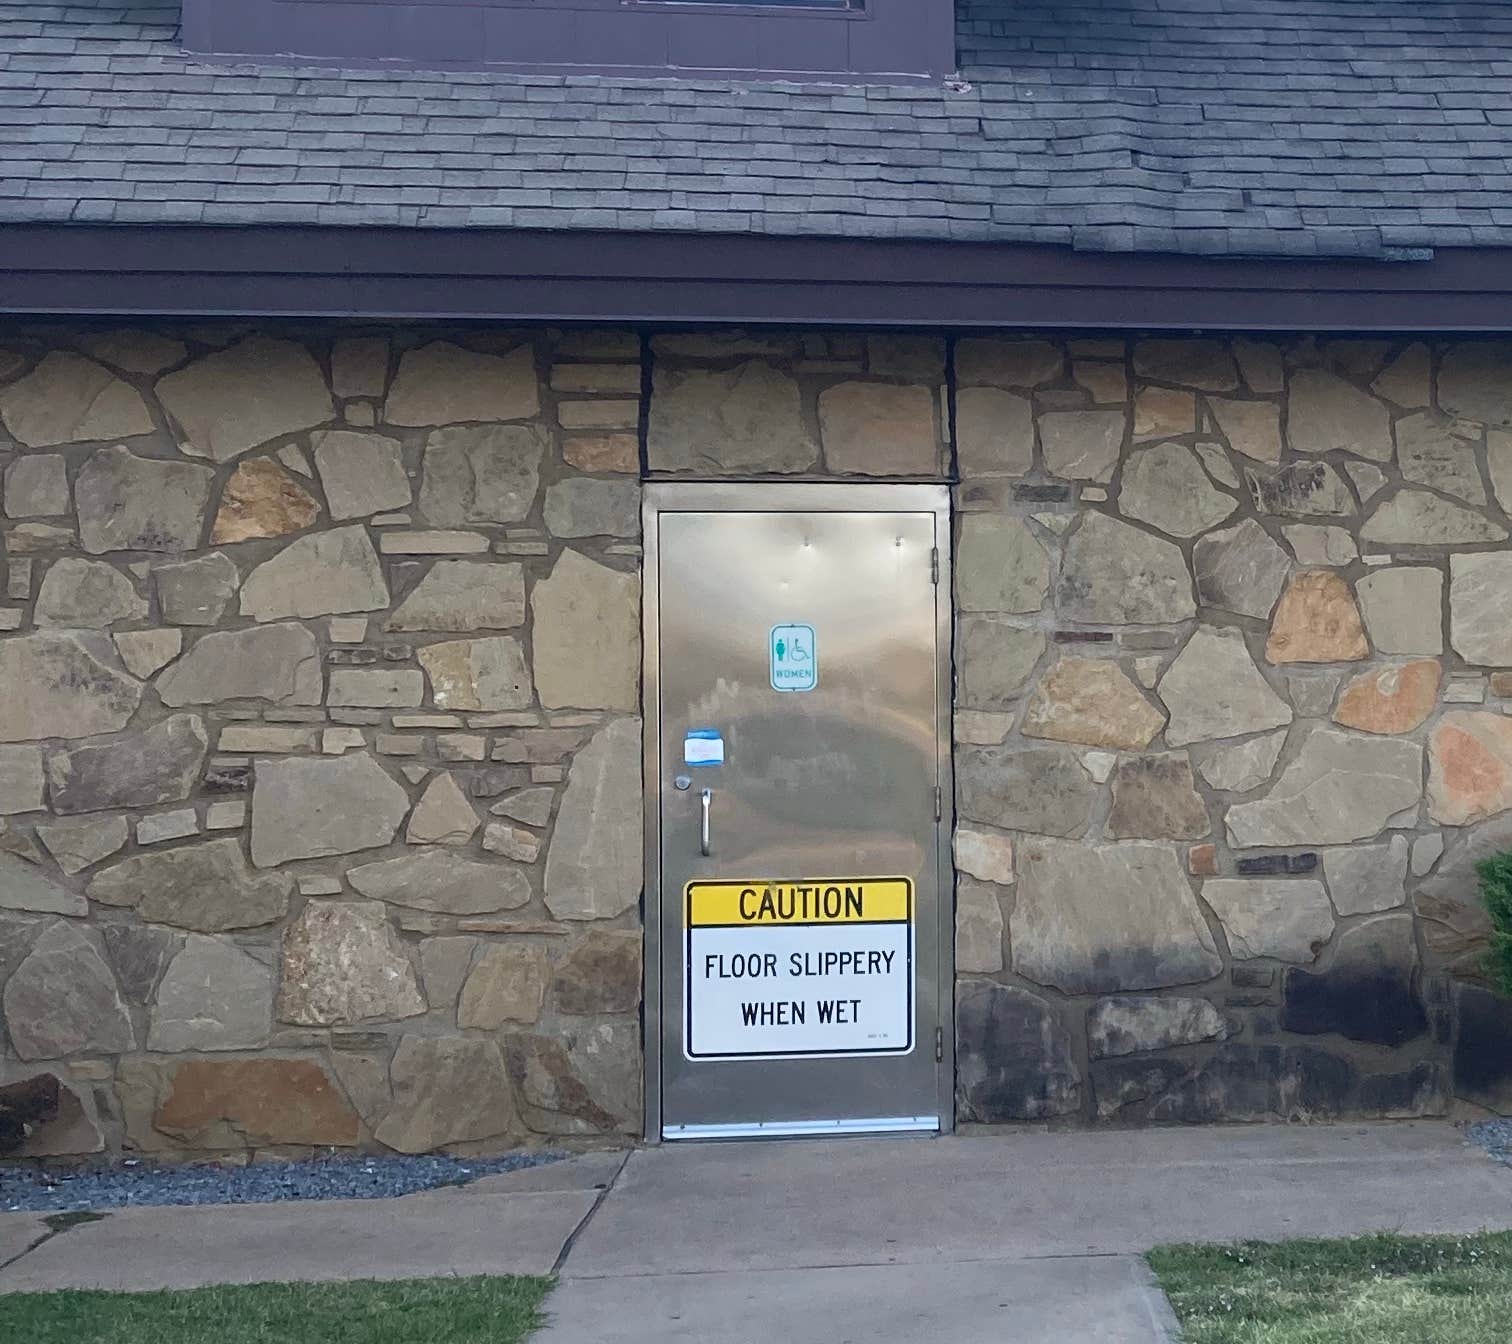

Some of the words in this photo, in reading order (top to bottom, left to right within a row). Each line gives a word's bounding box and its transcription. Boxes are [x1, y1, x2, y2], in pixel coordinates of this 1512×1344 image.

[776, 669, 811, 678] WOMEN
[739, 887, 863, 920] CAUTION
[705, 953, 777, 978] FLOOR
[789, 950, 896, 976] SLIPPERY
[741, 1001, 805, 1026] WHEN
[817, 999, 861, 1024] WET
